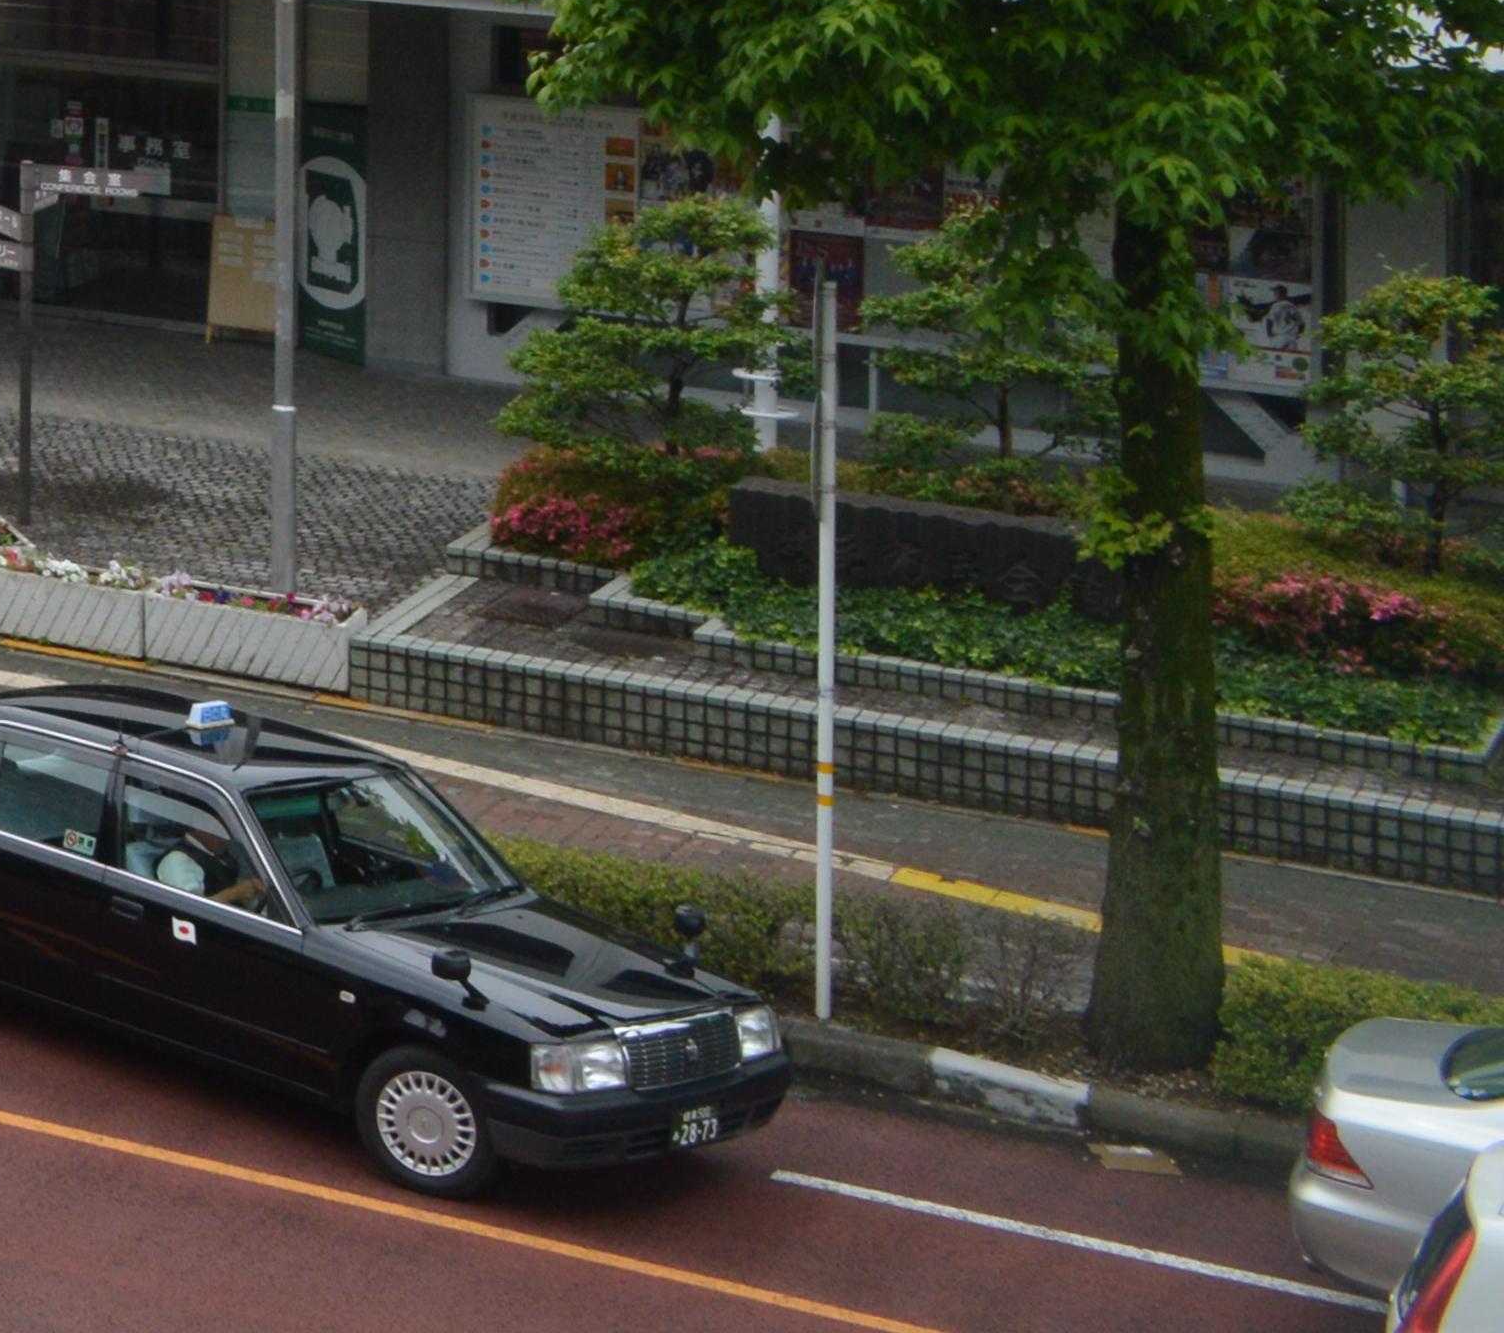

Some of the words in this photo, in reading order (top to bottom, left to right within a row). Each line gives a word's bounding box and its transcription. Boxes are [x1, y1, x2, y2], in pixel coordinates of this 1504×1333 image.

[117, 134, 192, 160] 事務室
[58, 169, 123, 188] 集会室
[40, 182, 102, 195] CONFERENCE
[104, 187, 139, 198] ROOMS
[680, 1117, 719, 1146] 28-73
